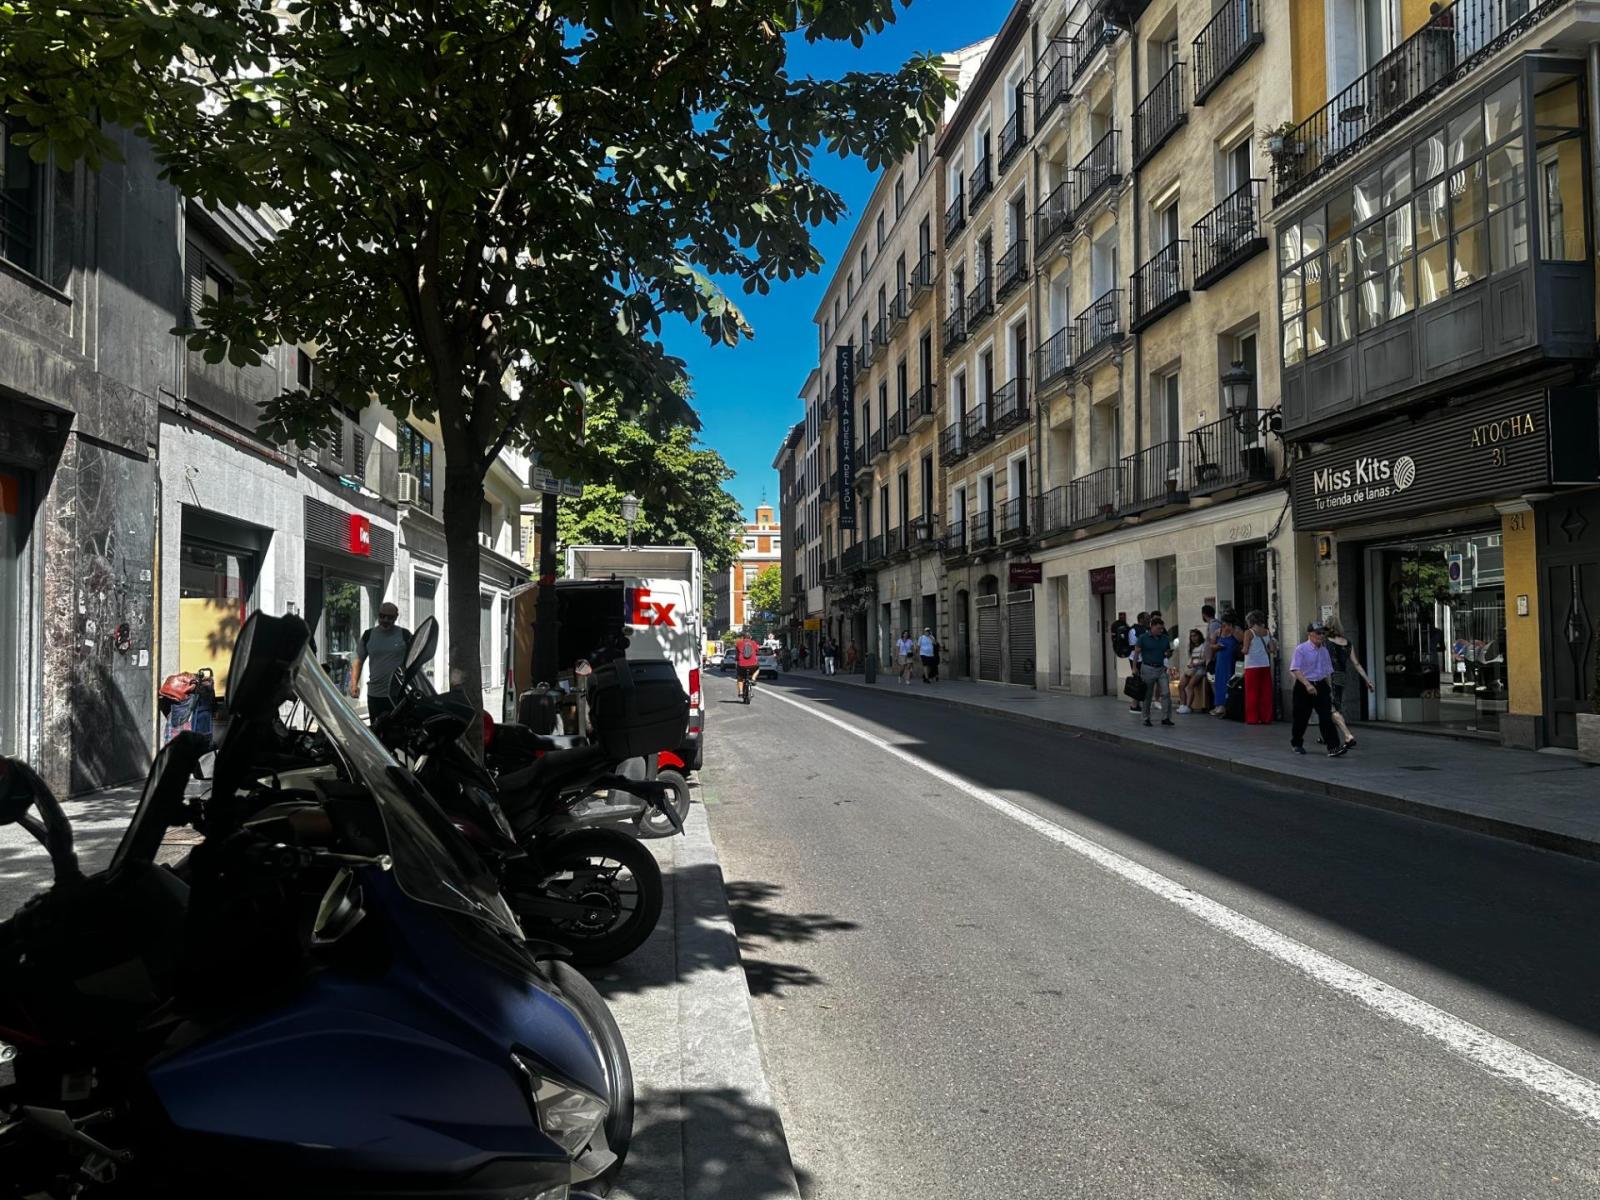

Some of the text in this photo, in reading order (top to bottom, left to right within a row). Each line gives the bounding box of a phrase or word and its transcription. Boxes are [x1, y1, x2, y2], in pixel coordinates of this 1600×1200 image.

[1470, 413, 1535, 448] ATOCHA
[1492, 448, 1507, 467] 31
[1314, 457, 1390, 495] Miss Kits
[1315, 486, 1390, 510] Tu tienda de lanas
[1510, 513, 1526, 531] 31
